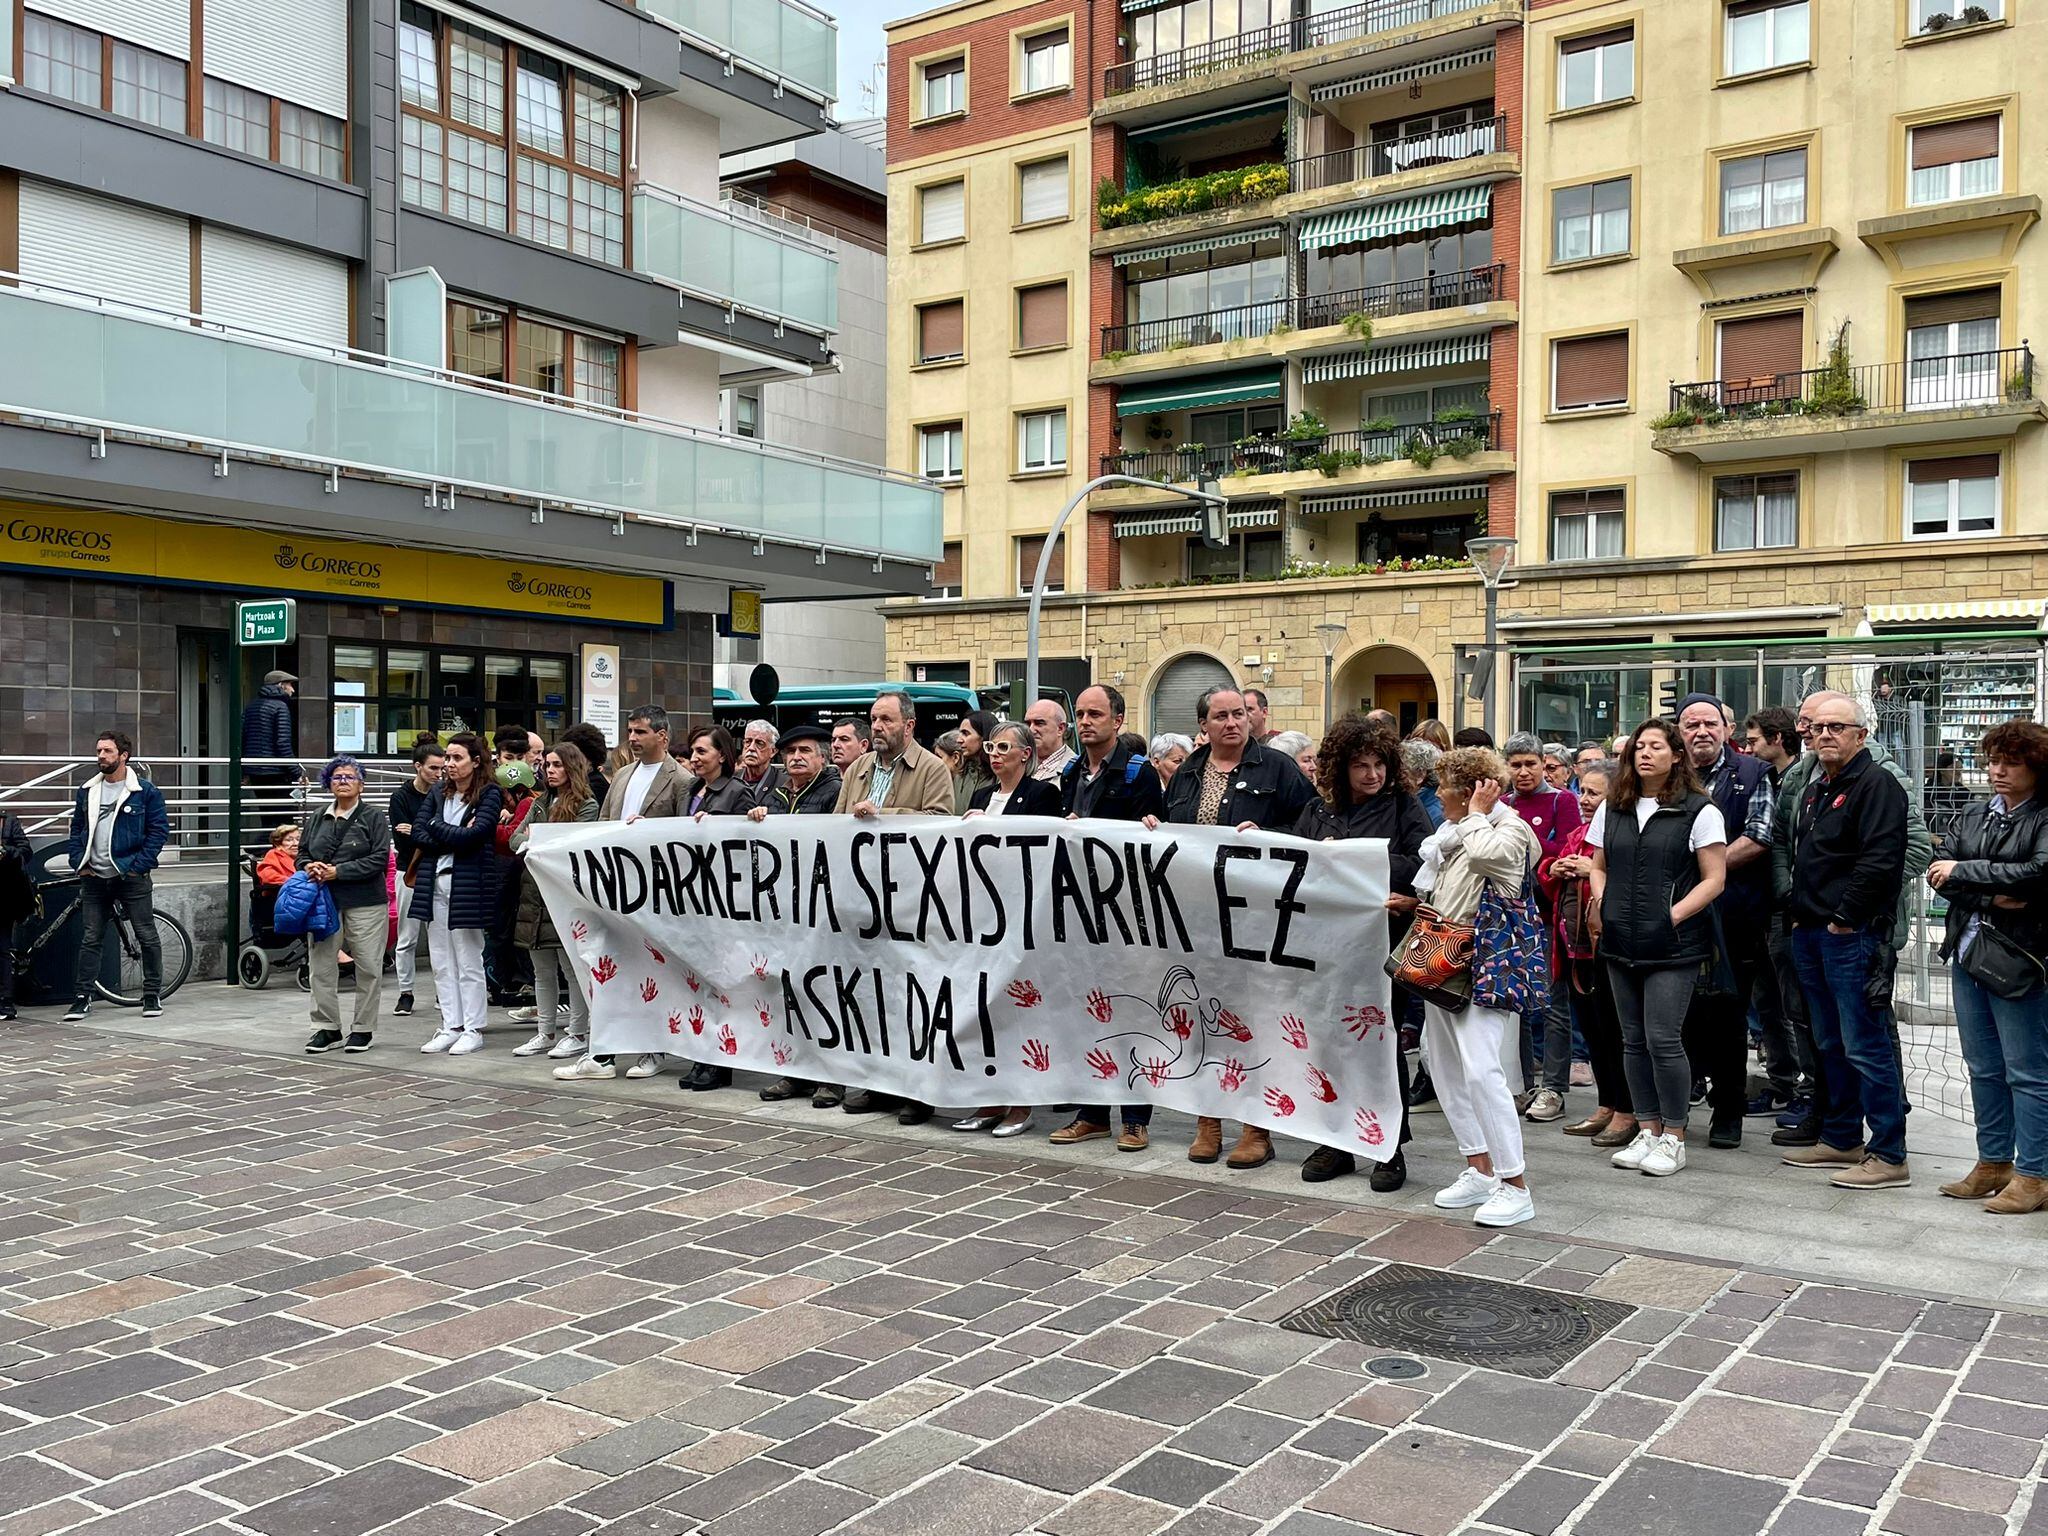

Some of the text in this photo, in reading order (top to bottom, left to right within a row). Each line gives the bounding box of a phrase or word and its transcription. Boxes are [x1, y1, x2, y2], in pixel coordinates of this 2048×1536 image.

[7, 519, 112, 551] CORREOS
[301, 552, 382, 578] CORREOS
[528, 578, 592, 600] CORREOS
[245, 609, 284, 622] Martxoak 8
[257, 625, 275, 634] Plaza
[590, 671, 613, 680] Correos
[569, 831, 1317, 971] INDARKERIA SEXISTARIK EZ
[781, 965, 890, 1057] ASKI
